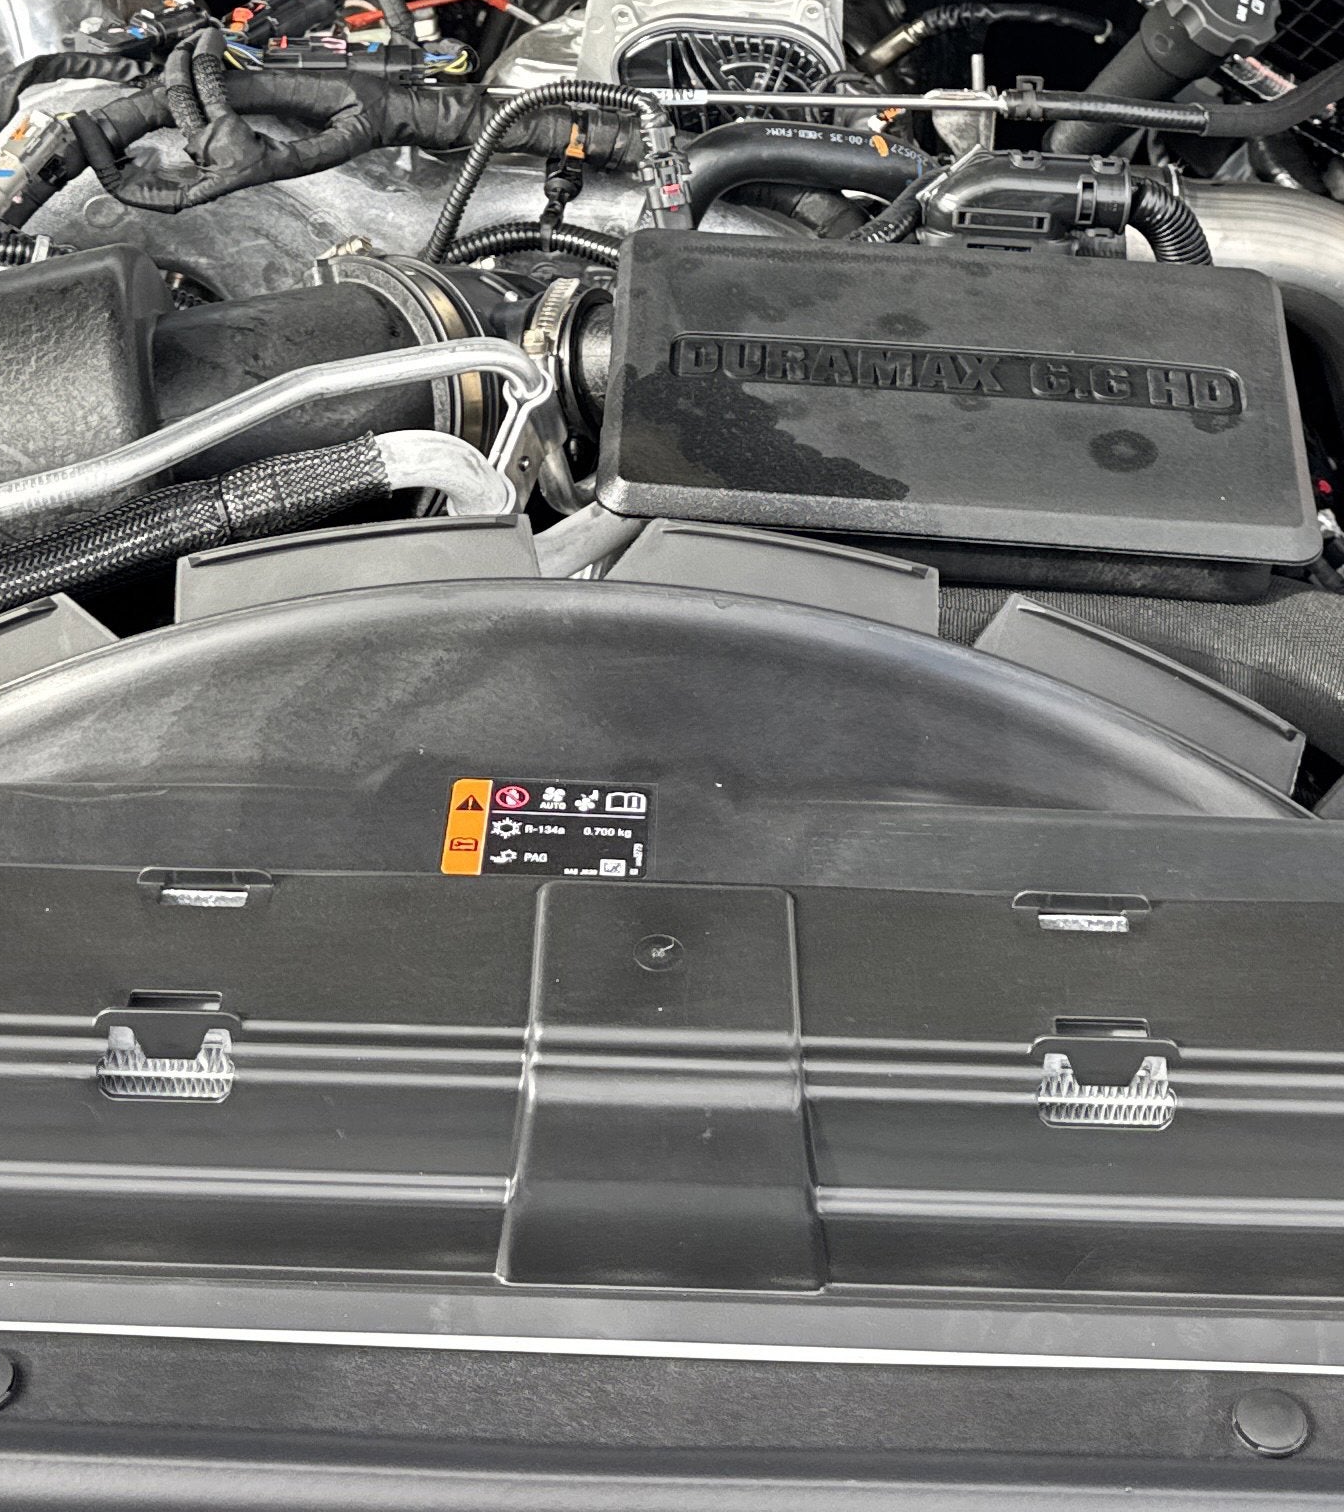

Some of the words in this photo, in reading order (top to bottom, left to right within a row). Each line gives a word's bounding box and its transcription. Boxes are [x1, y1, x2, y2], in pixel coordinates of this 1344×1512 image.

[680, 339, 1002, 393] DURAMAX
[1030, 360, 1130, 402] 6.6
[1147, 367, 1235, 412] HD
[540, 802, 566, 810] AUTO
[524, 824, 566, 835] R-134a
[583, 826, 616, 837] 0.700
[617, 828, 632, 838] kg
[523, 852, 548, 863] PAG
